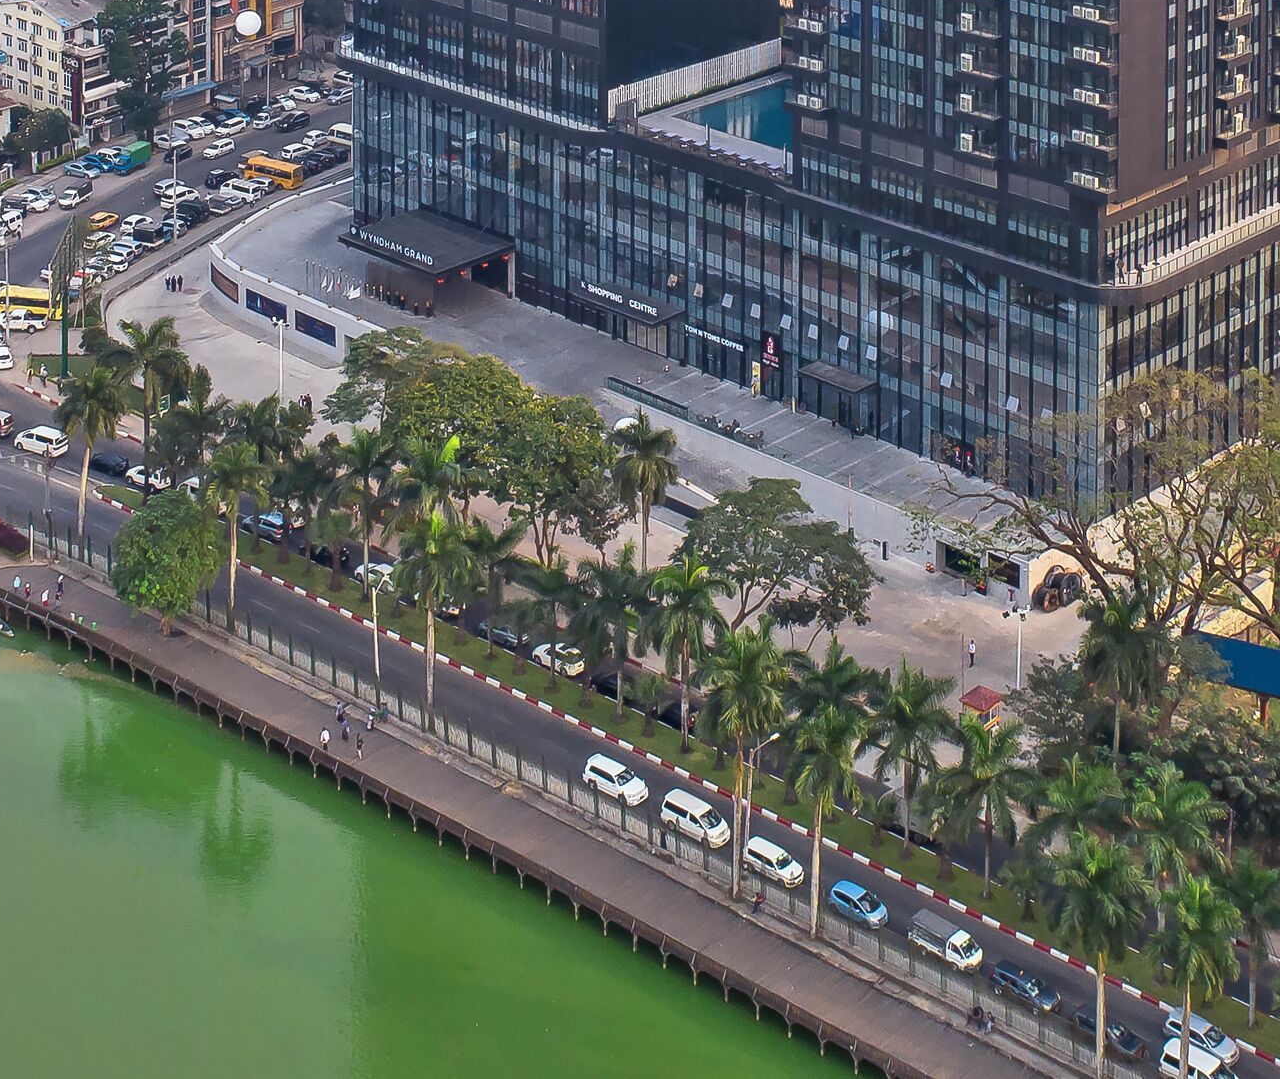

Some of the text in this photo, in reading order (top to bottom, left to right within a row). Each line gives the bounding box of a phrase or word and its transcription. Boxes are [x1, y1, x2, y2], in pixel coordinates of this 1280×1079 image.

[359, 229, 434, 266] WYNDHAM GRAND
[587, 283, 623, 304] SHOPPING
[628, 299, 658, 317] CENTRE
[684, 324, 698, 335] TOM
[703, 331, 721, 344] TOMS
[721, 337, 744, 352] COFFEE
